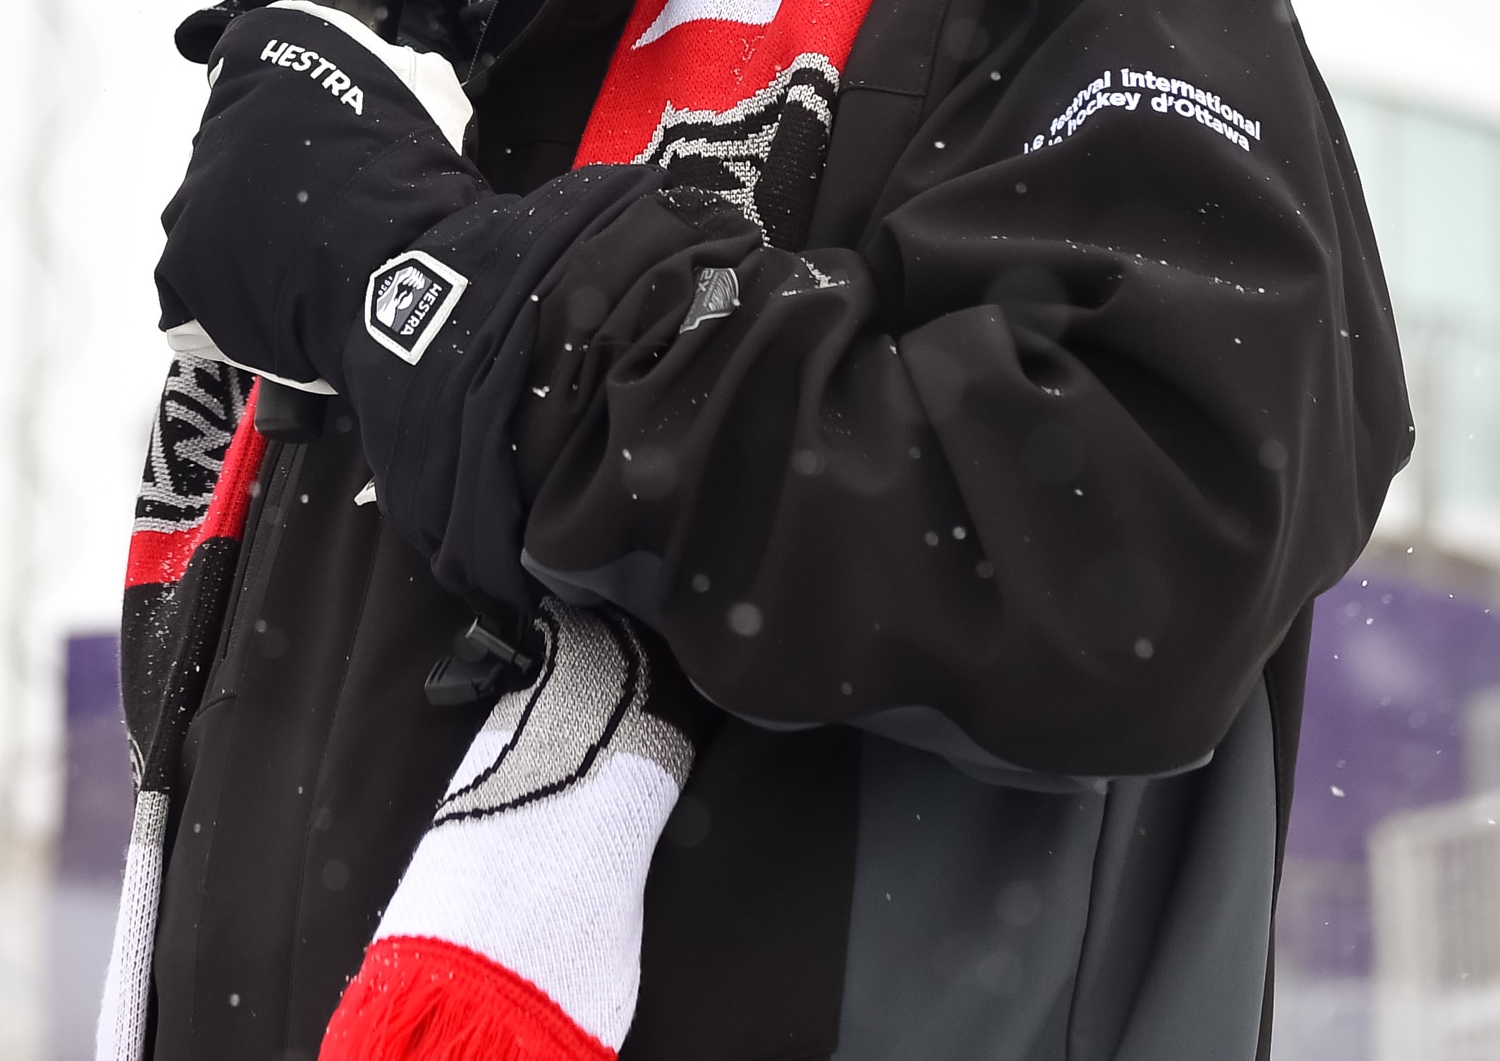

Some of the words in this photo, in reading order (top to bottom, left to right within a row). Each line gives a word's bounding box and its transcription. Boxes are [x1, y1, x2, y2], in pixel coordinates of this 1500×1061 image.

[260, 39, 364, 116] HESTRA
[1067, 91, 1142, 136] hockey
[1150, 93, 1250, 152] d'Ottawa
[400, 283, 443, 335] HESTRA
